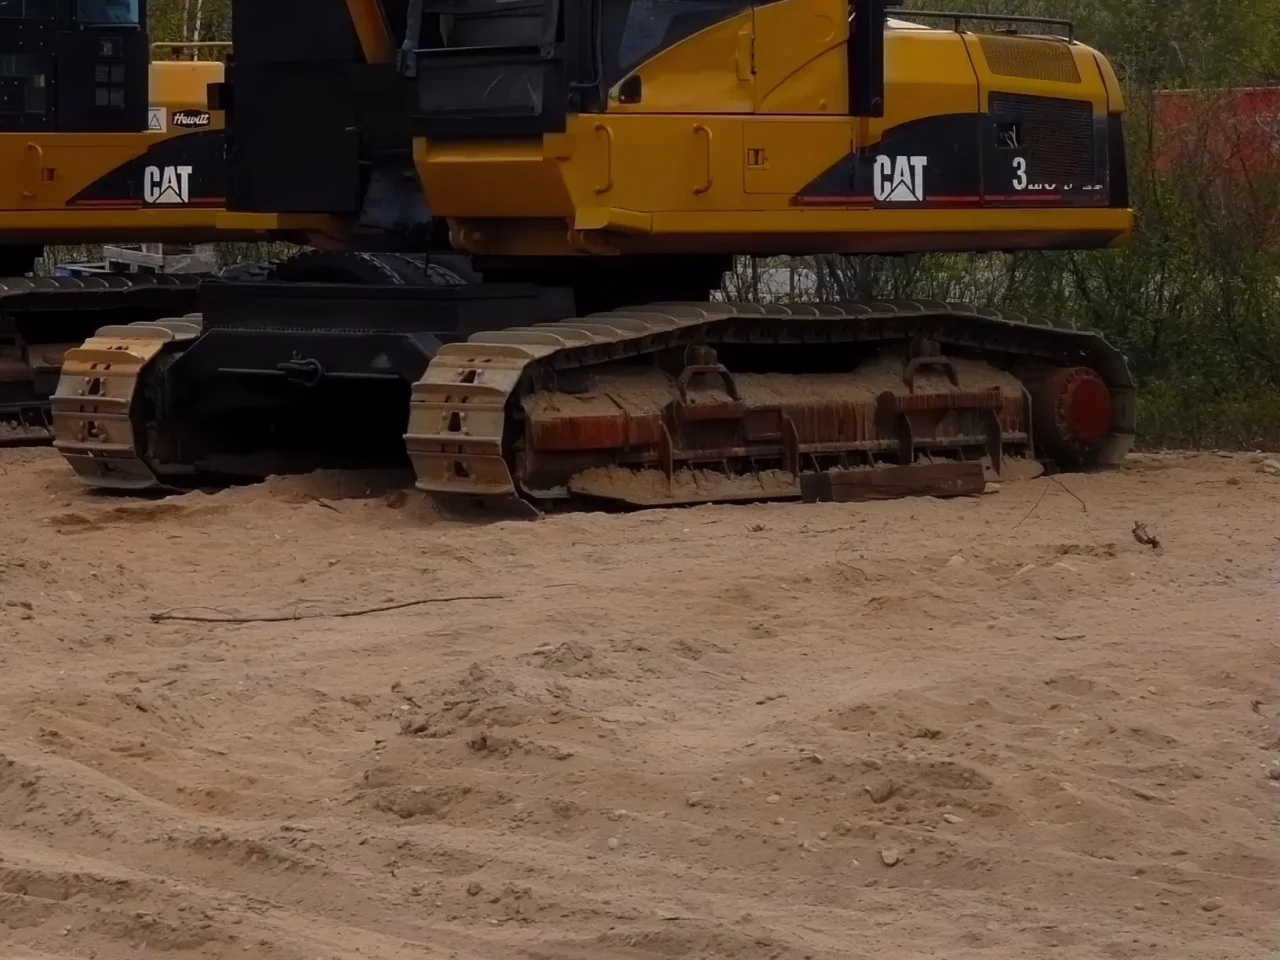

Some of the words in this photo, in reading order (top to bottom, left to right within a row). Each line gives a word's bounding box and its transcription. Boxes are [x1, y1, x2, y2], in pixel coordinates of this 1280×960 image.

[173, 112, 209, 125] Hewitt
[143, 165, 193, 203] CAT
[873, 154, 927, 201] CAT
